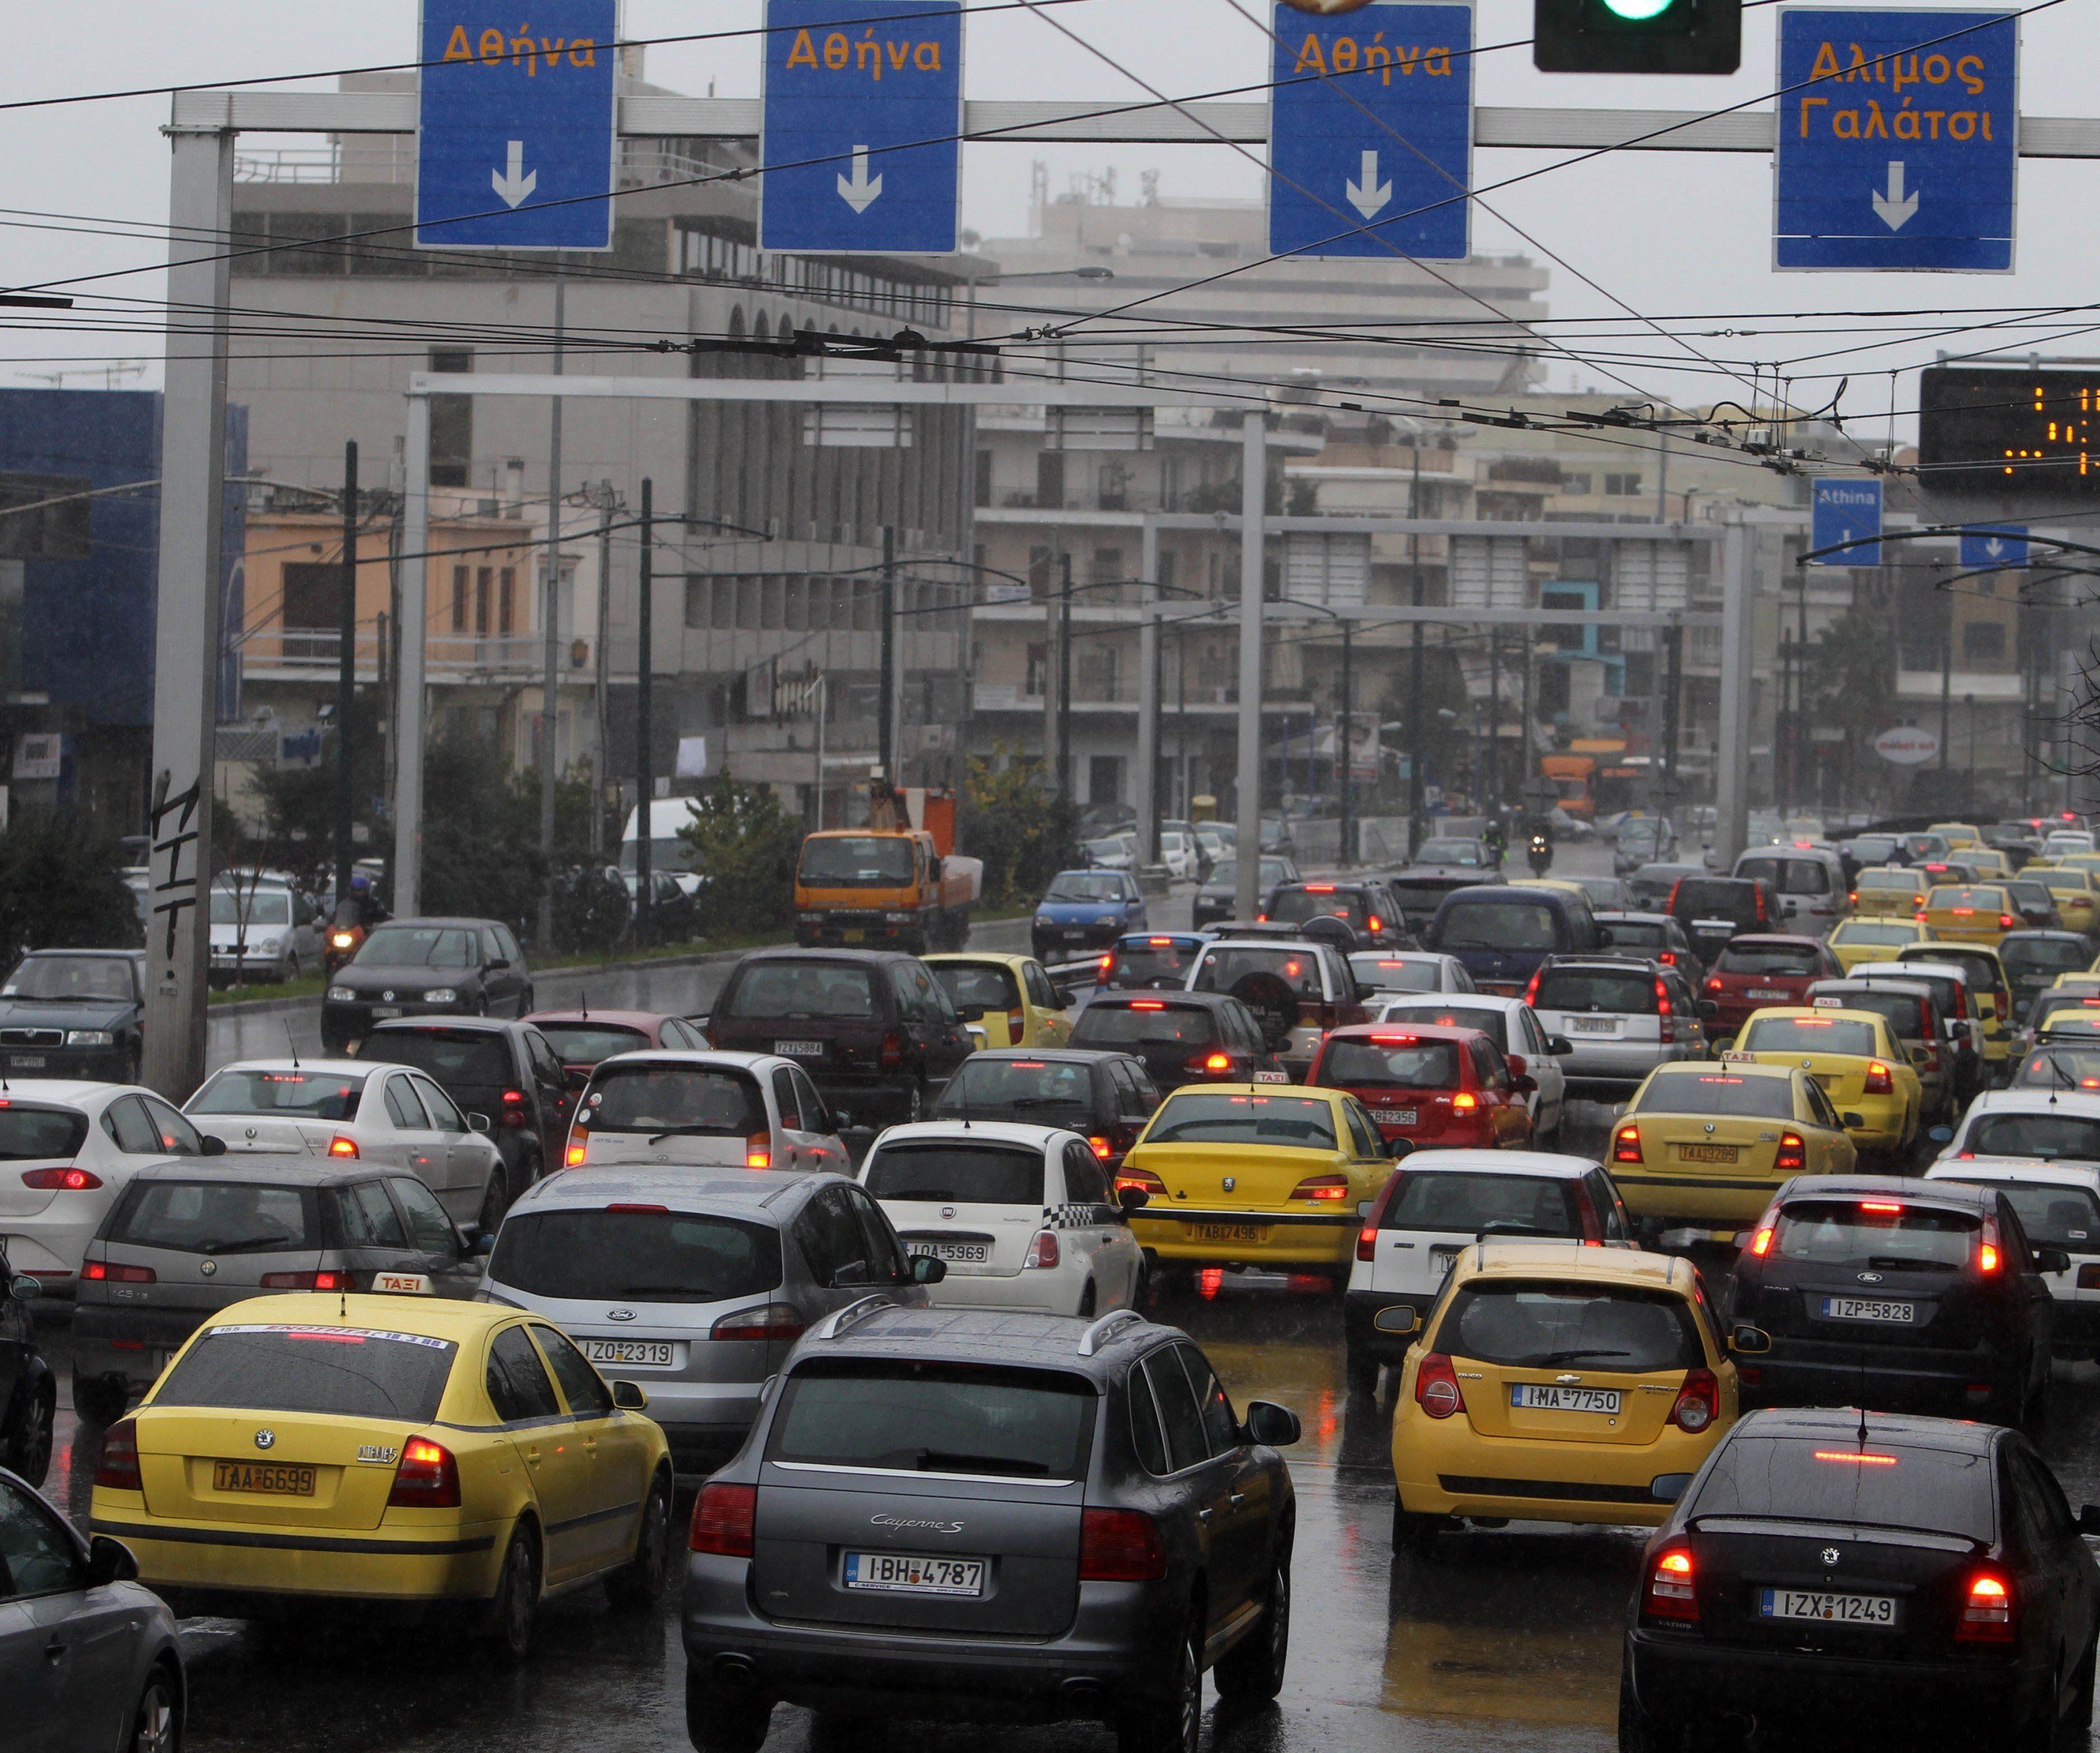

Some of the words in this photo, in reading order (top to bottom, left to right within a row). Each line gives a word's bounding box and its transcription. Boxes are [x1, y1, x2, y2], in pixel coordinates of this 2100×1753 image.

[443, 24, 596, 77] Αθήνα
[786, 27, 942, 81] Αθήνα
[1293, 32, 1452, 86] Αθήνα
[1809, 42, 1984, 95] Αλιμος
[1800, 96, 1993, 141] Γαλάτσι
[1819, 489, 1876, 505] Athina
[382, 1277, 421, 1290] ΤΑΞΙ
[871, 1513, 944, 1531] Cayenne
[940, 1521, 965, 1533] S
